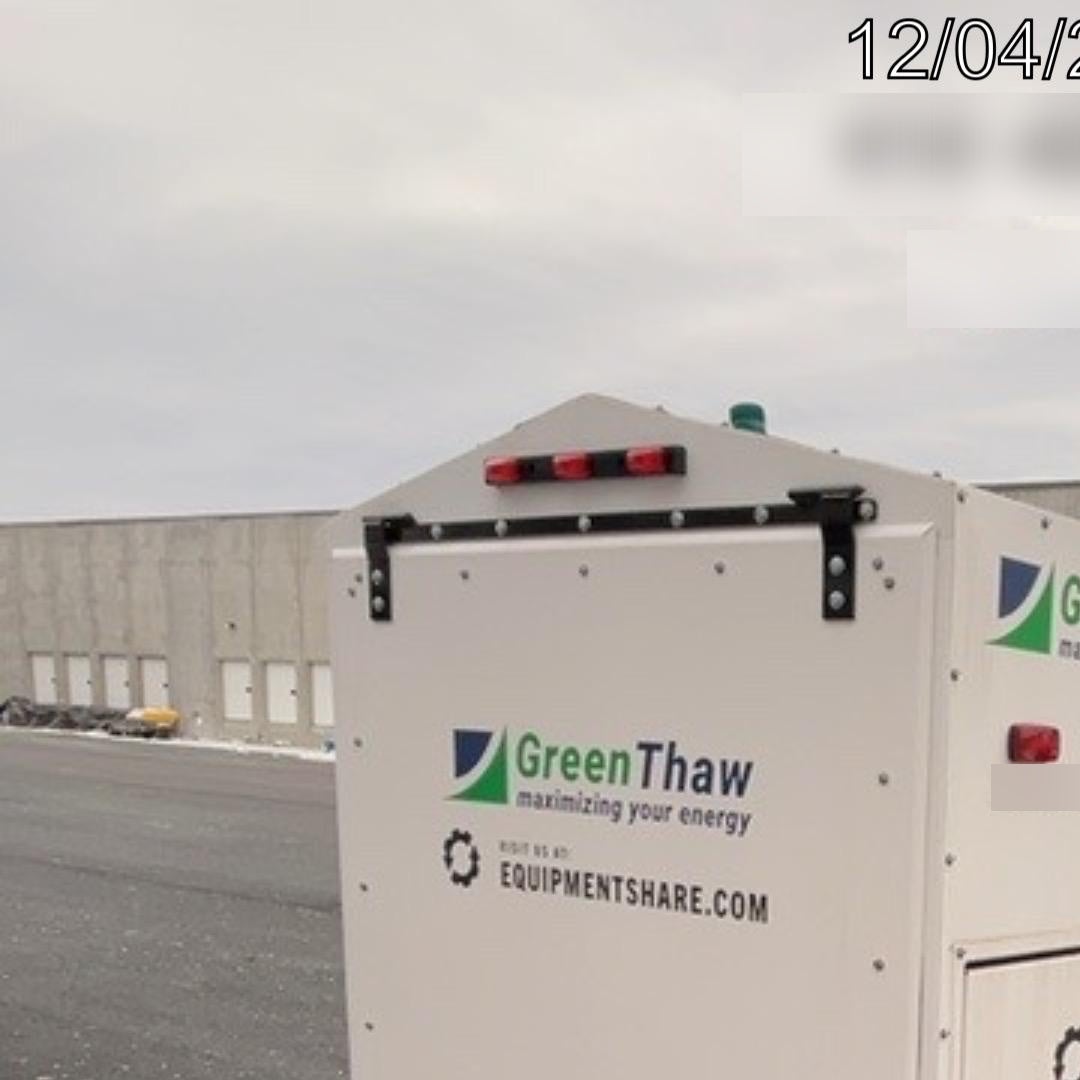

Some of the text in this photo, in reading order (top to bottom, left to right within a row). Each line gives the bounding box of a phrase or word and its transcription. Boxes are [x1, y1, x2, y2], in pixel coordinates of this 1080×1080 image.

[516, 732, 754, 798] GreenThaw
[515, 789, 751, 837] maximizing your energy
[500, 861, 769, 924] EQUIPMENTSHARE.COM
